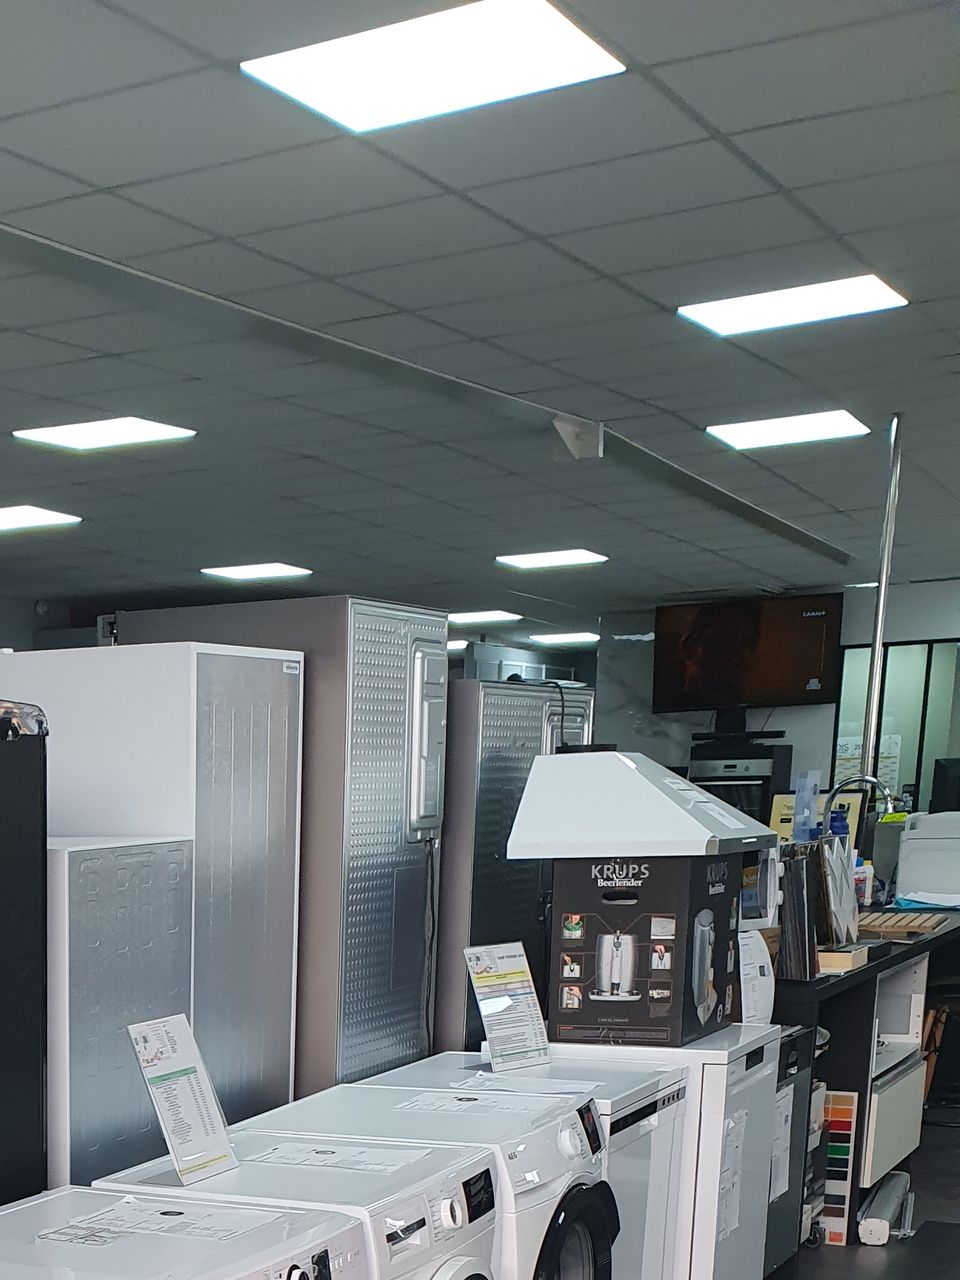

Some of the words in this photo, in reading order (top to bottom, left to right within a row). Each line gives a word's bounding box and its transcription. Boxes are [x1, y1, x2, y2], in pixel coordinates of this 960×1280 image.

[591, 864, 650, 879] KRUPS
[597, 878, 643, 887] BeerTender
[507, 1151, 518, 1160] AEG
